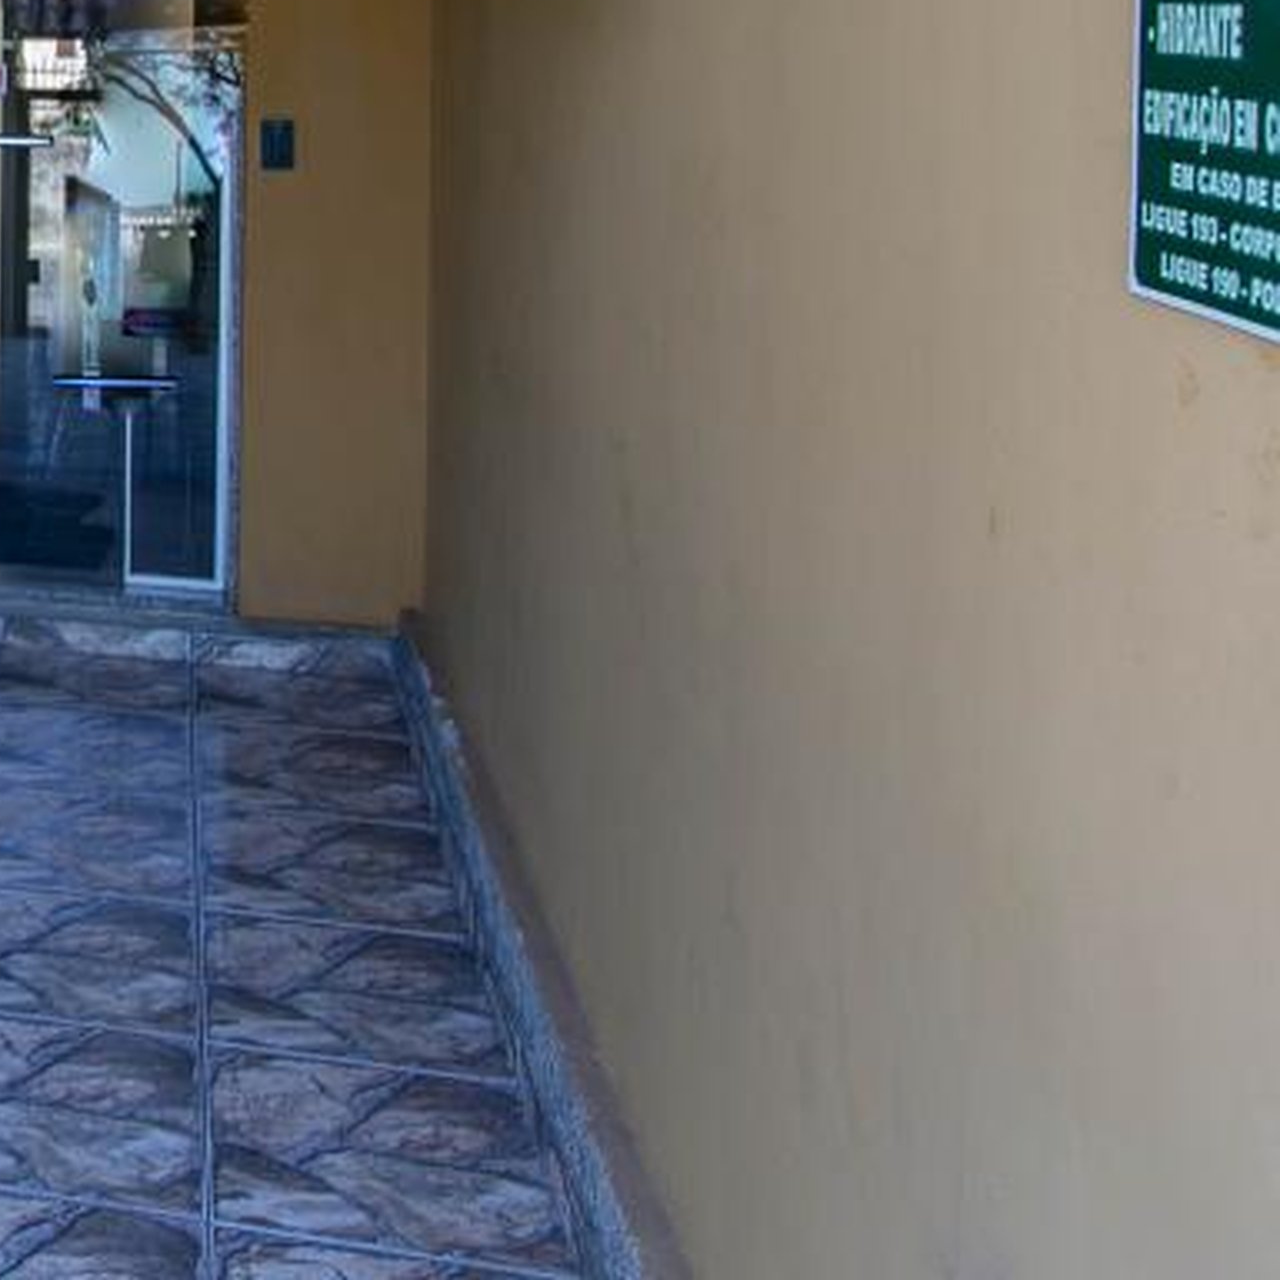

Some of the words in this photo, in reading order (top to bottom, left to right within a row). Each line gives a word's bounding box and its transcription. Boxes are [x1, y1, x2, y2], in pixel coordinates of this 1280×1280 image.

[1157, 3, 1243, 59] HIDRANTE
[1144, 86, 1231, 155] EDIFICAÇÃO
[1233, 98, 1259, 153] EM
[1169, 161, 1194, 192] EM
[1197, 166, 1243, 202] CASO
[1245, 175, 1270, 208] DE
[1142, 200, 1189, 239] LIGUE
[1191, 213, 1218, 246] 193
[1160, 251, 1210, 291] LIGUE
